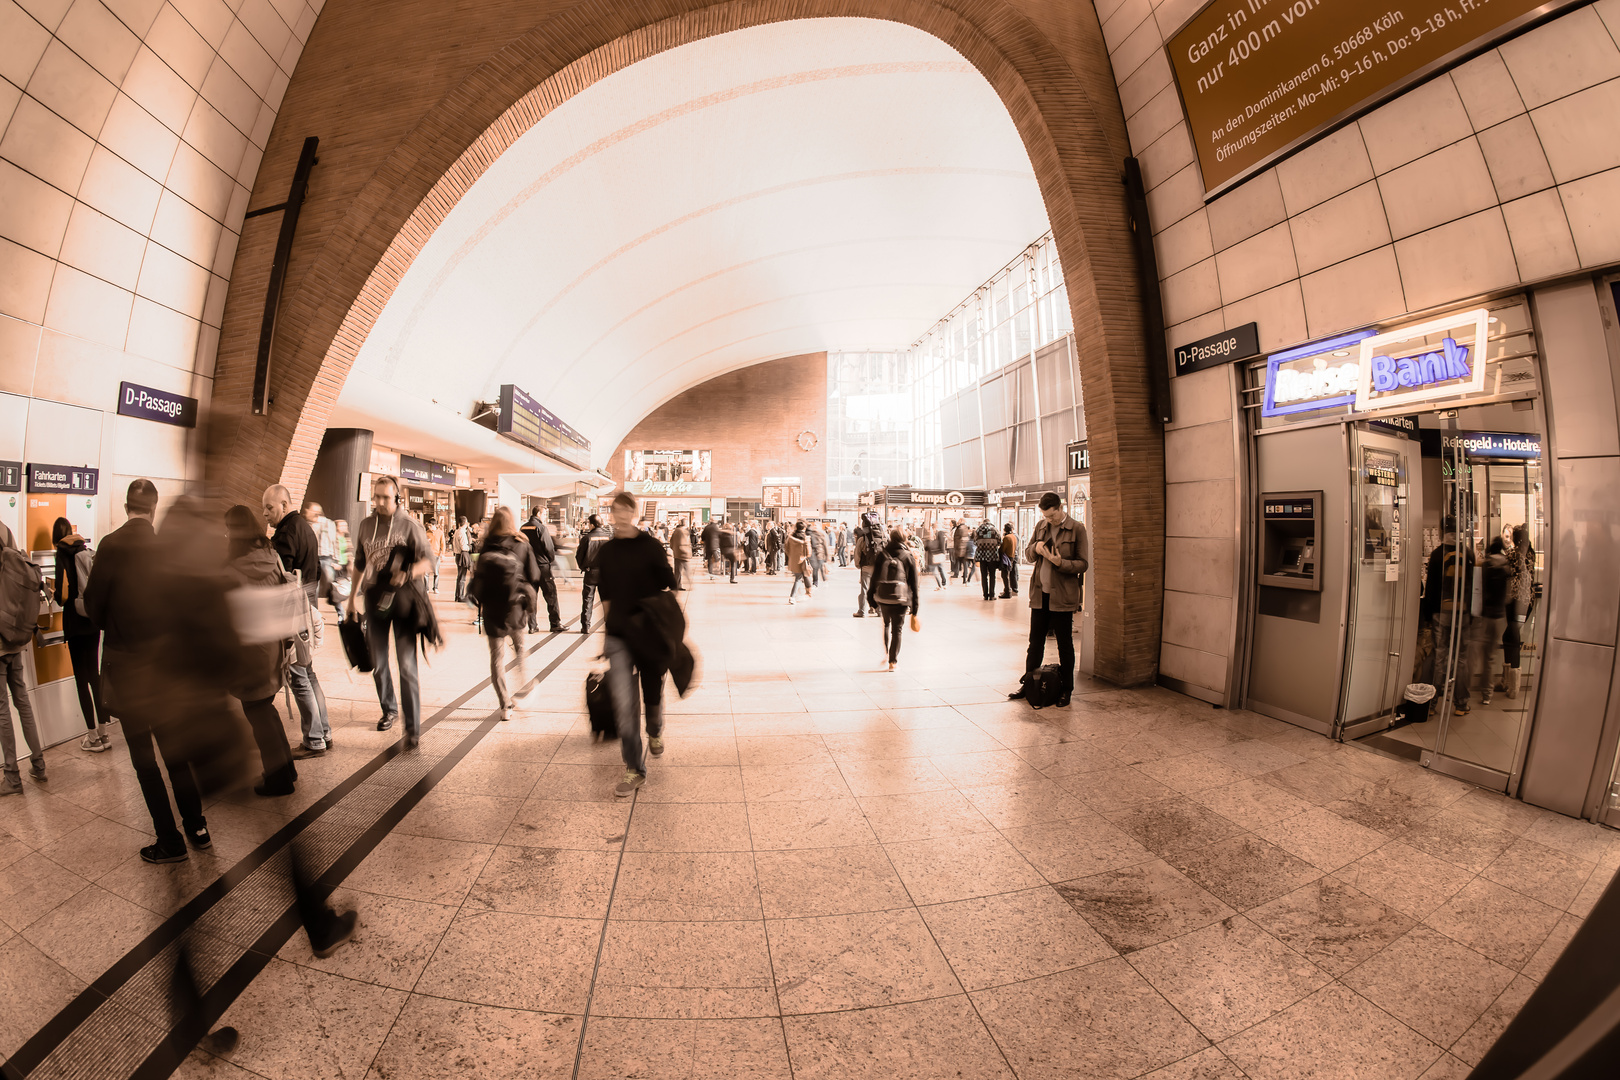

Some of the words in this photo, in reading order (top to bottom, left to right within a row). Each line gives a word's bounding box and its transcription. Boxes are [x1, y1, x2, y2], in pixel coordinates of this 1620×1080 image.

[1187, 24, 1229, 64] Ganz
[1226, 9, 1248, 31] in
[1196, 61, 1225, 94] nur
[1228, 30, 1261, 67] 400
[1261, 19, 1282, 42] m
[1211, 128, 1226, 144] An
[1225, 113, 1246, 133] den
[1244, 63, 1321, 119] Dominikanern
[1320, 53, 1335, 68] 6,
[1333, 26, 1374, 60] 50668
[1372, 10, 1405, 35] Köln
[1215, 104, 1298, 163] Öffnungszeiten:
[1371, 50, 1388, 64] h,
[1386, 35, 1412, 56] Do:
[1443, 7, 1463, 22] h,
[1178, 337, 1237, 366] D-Passage
[1371, 338, 1471, 392] Bank
[125, 387, 183, 418] D-Passage
[1442, 435, 1493, 452] Reisegeld
[1502, 438, 1541, 452] Hotelre
[34, 470, 67, 482] Fahrkarten
[642, 478, 694, 497] Douglas
[910, 492, 946, 506] Kamps
